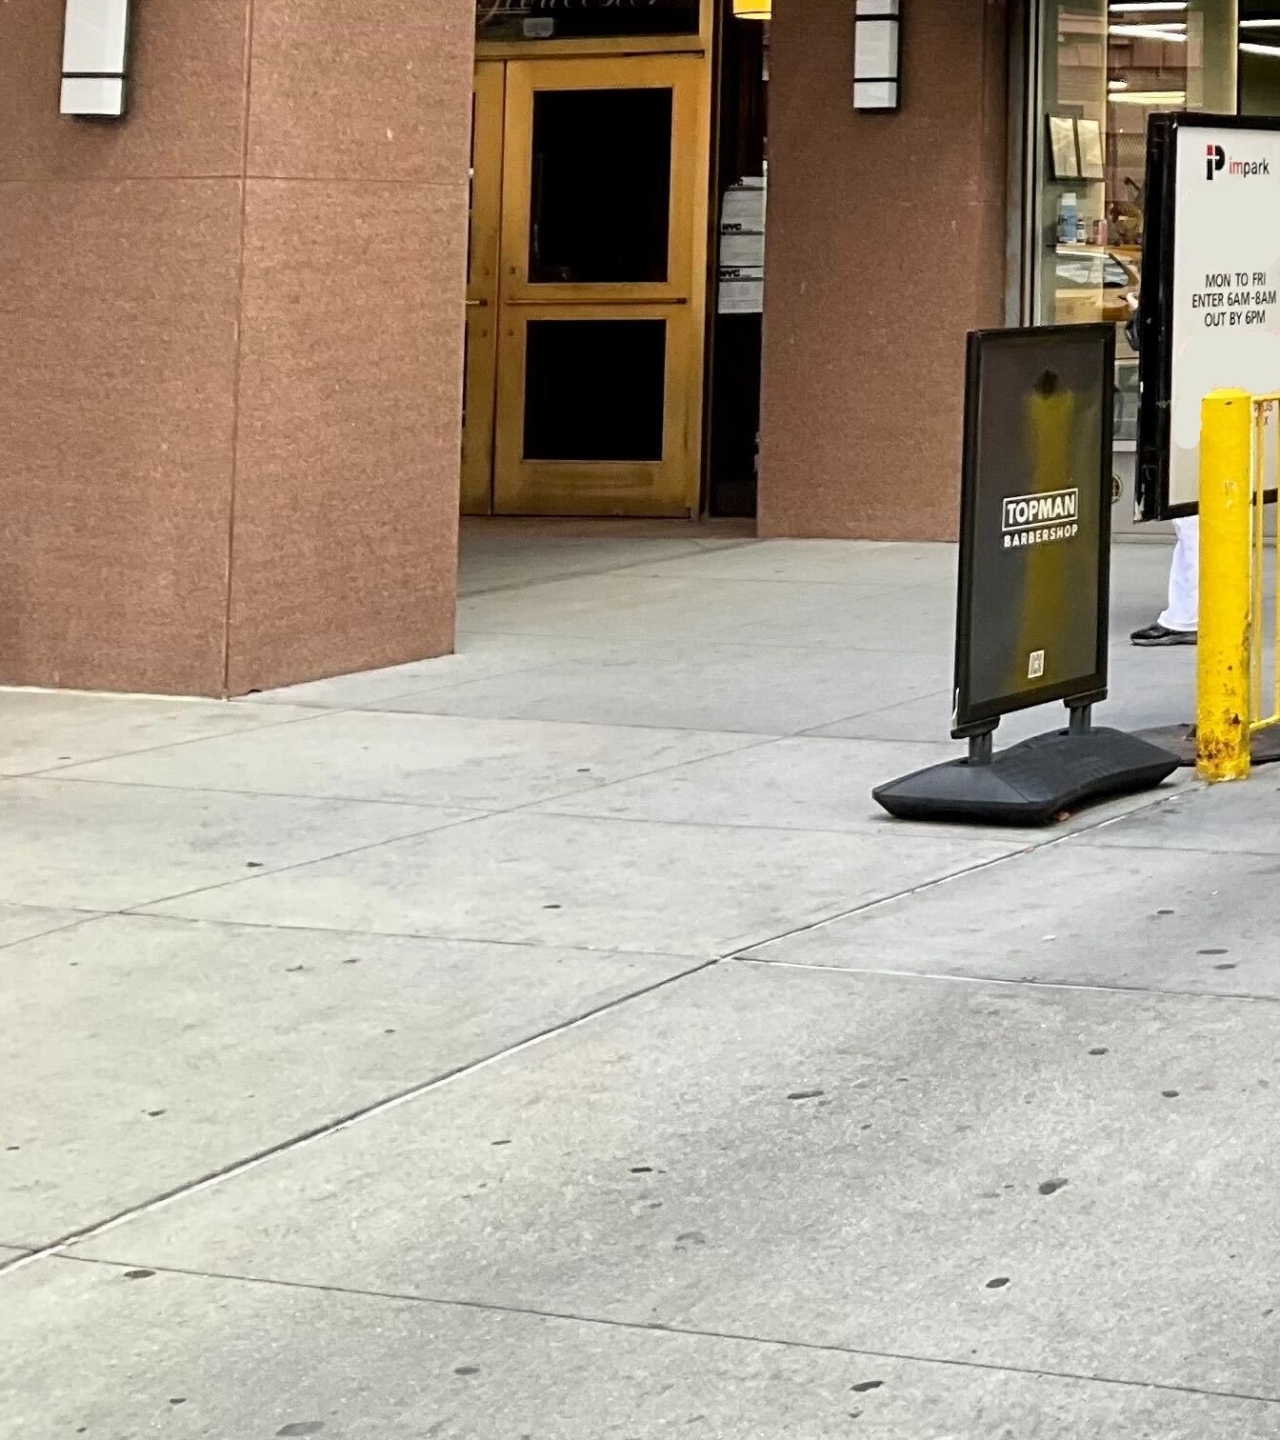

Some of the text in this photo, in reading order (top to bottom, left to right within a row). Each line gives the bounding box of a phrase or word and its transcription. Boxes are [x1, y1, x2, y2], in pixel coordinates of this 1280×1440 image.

[1229, 158, 1271, 178] impark
[721, 223, 742, 231] NYC
[719, 269, 741, 277] NYC
[1205, 272, 1266, 288] MON TO FRI
[1192, 290, 1277, 308] ENTER 6AM-8AM
[1204, 310, 1266, 327] OUT BY 6PM
[1006, 493, 1075, 525] TOPMAN
[1003, 523, 1078, 549] BARBERSHOP
